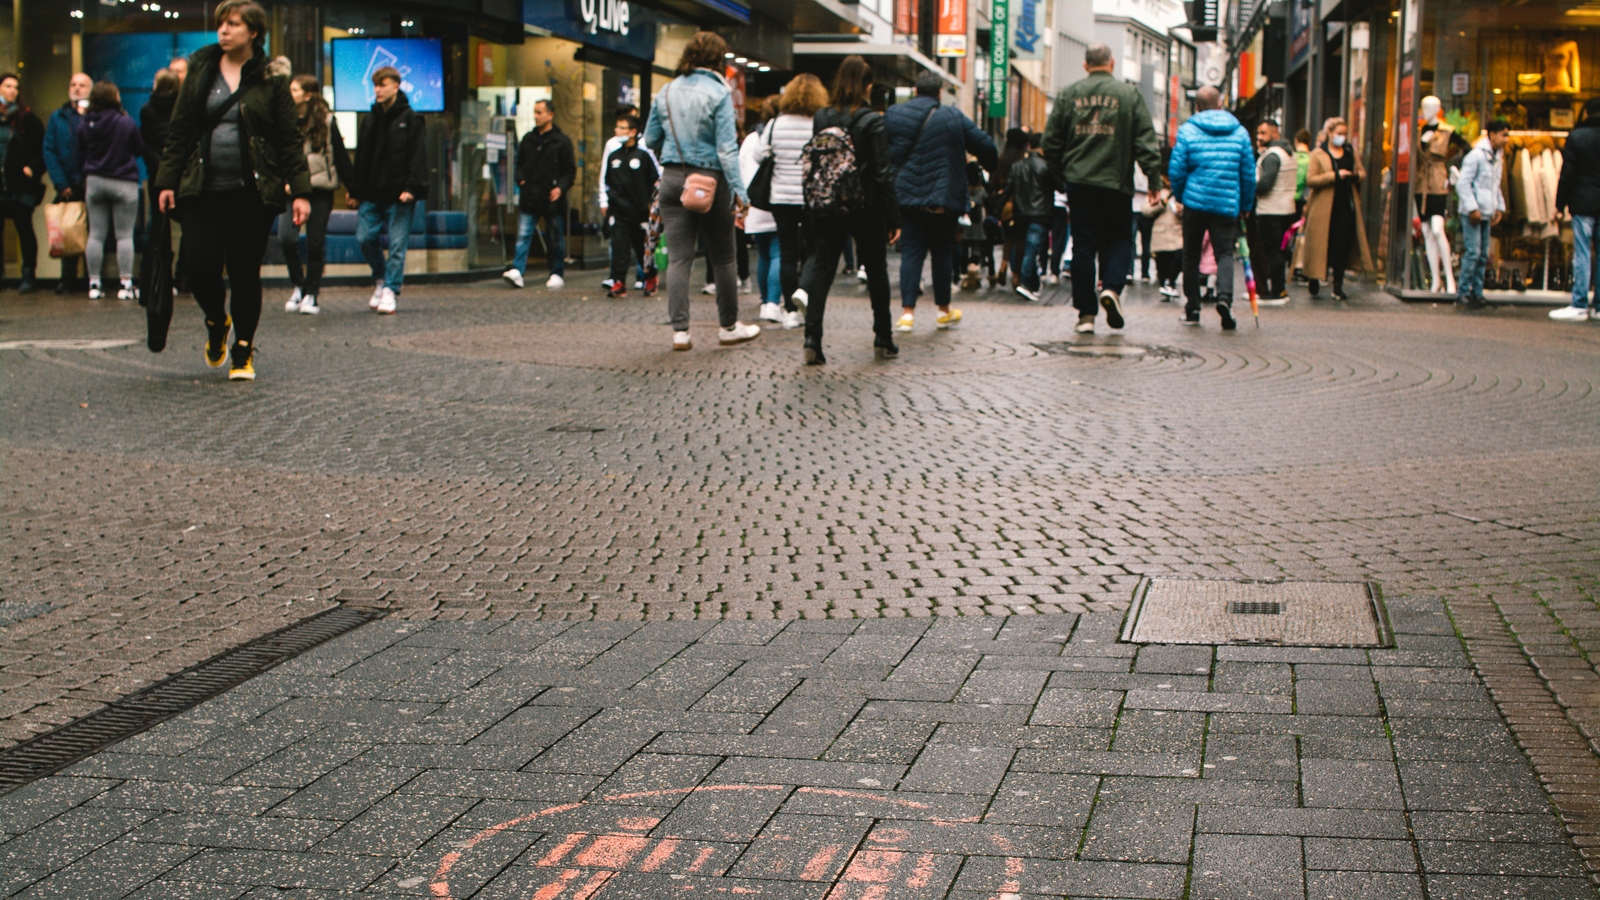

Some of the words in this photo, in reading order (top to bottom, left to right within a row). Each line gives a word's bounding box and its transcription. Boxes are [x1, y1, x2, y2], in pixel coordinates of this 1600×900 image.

[994, 5, 1006, 20] OF
[993, 23, 1005, 65] COLORS
[992, 67, 1004, 104] UNITED
